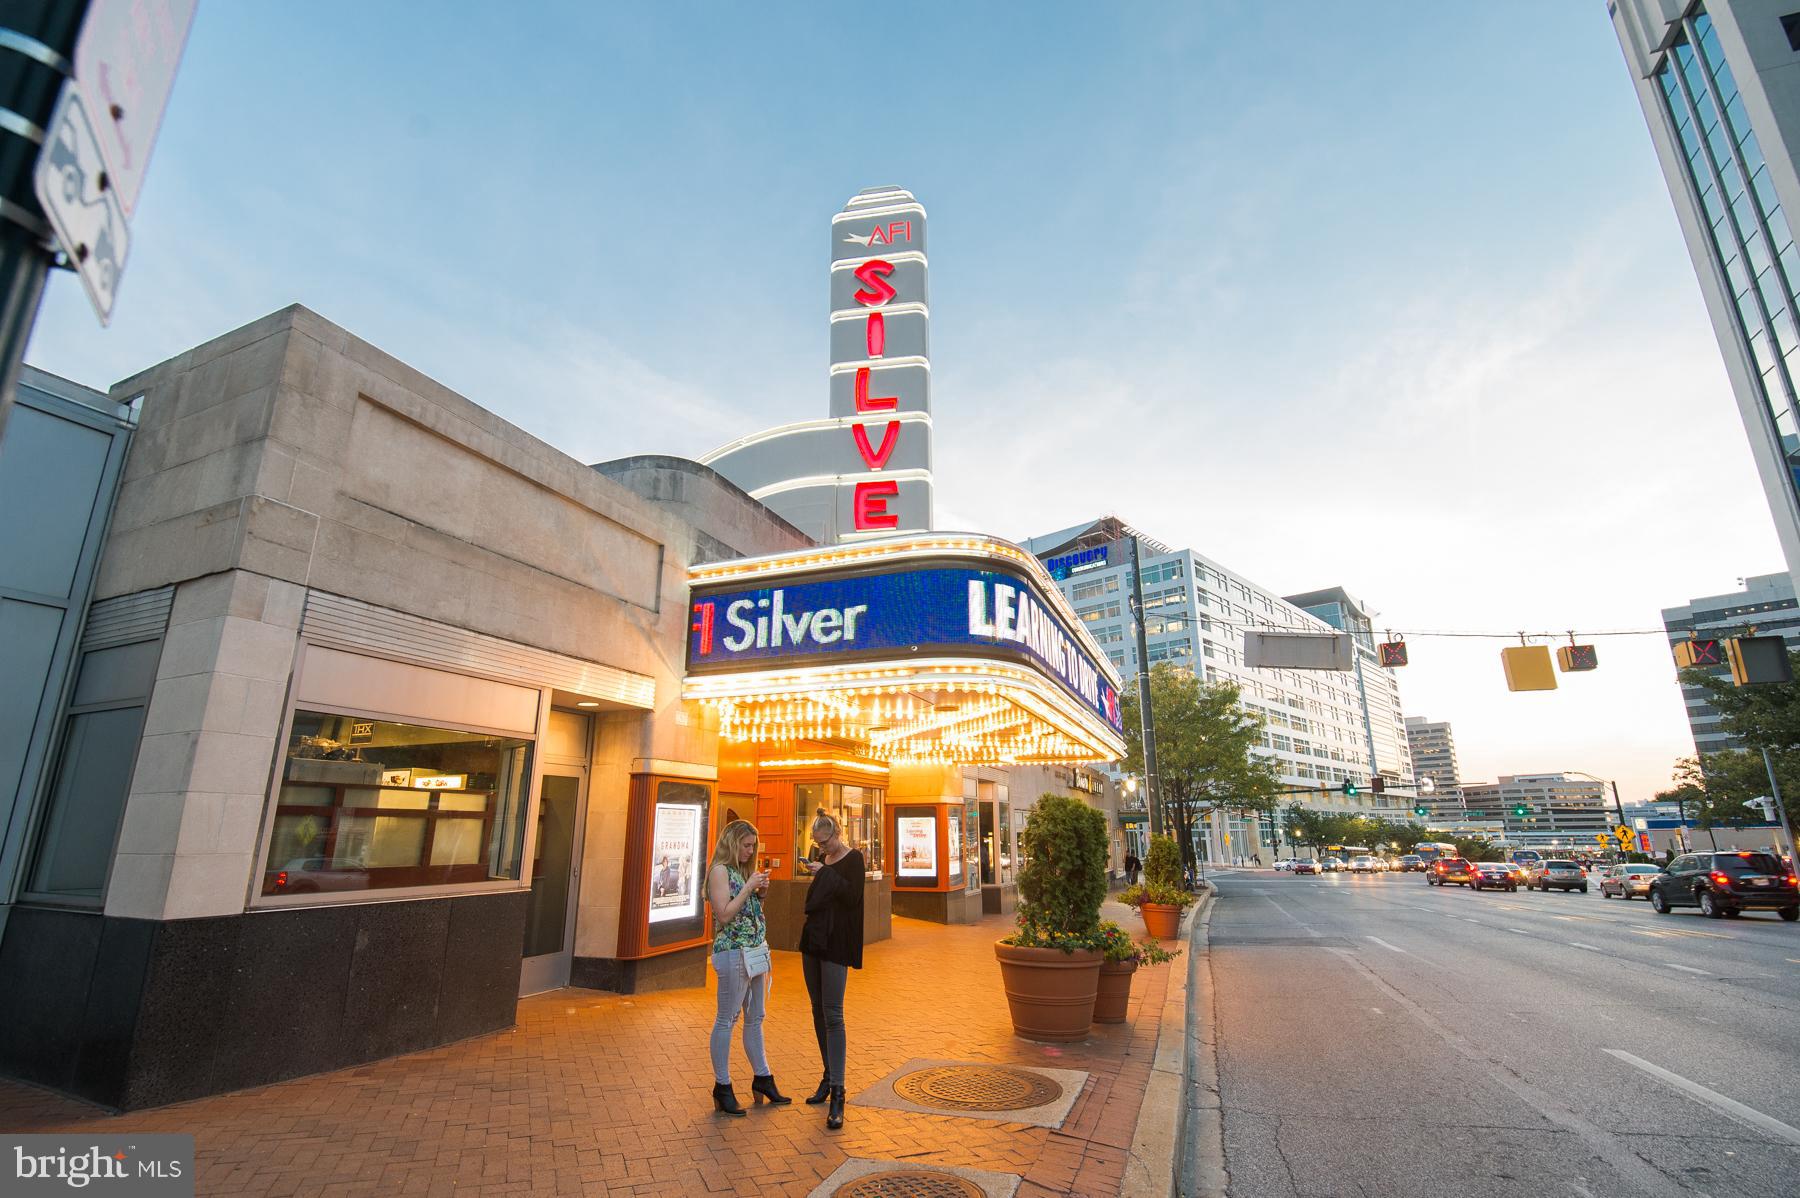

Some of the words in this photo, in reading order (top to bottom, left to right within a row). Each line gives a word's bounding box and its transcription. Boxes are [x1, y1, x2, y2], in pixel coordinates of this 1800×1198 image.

[867, 220, 911, 248] AFI
[723, 589, 868, 652] Silver
[968, 579, 1066, 678] LEARNING
[1065, 641, 1078, 690] TO
[1078, 653, 1099, 709] DRIVE
[353, 724, 373, 735] THX
[660, 840, 689, 850] GRANDMA
